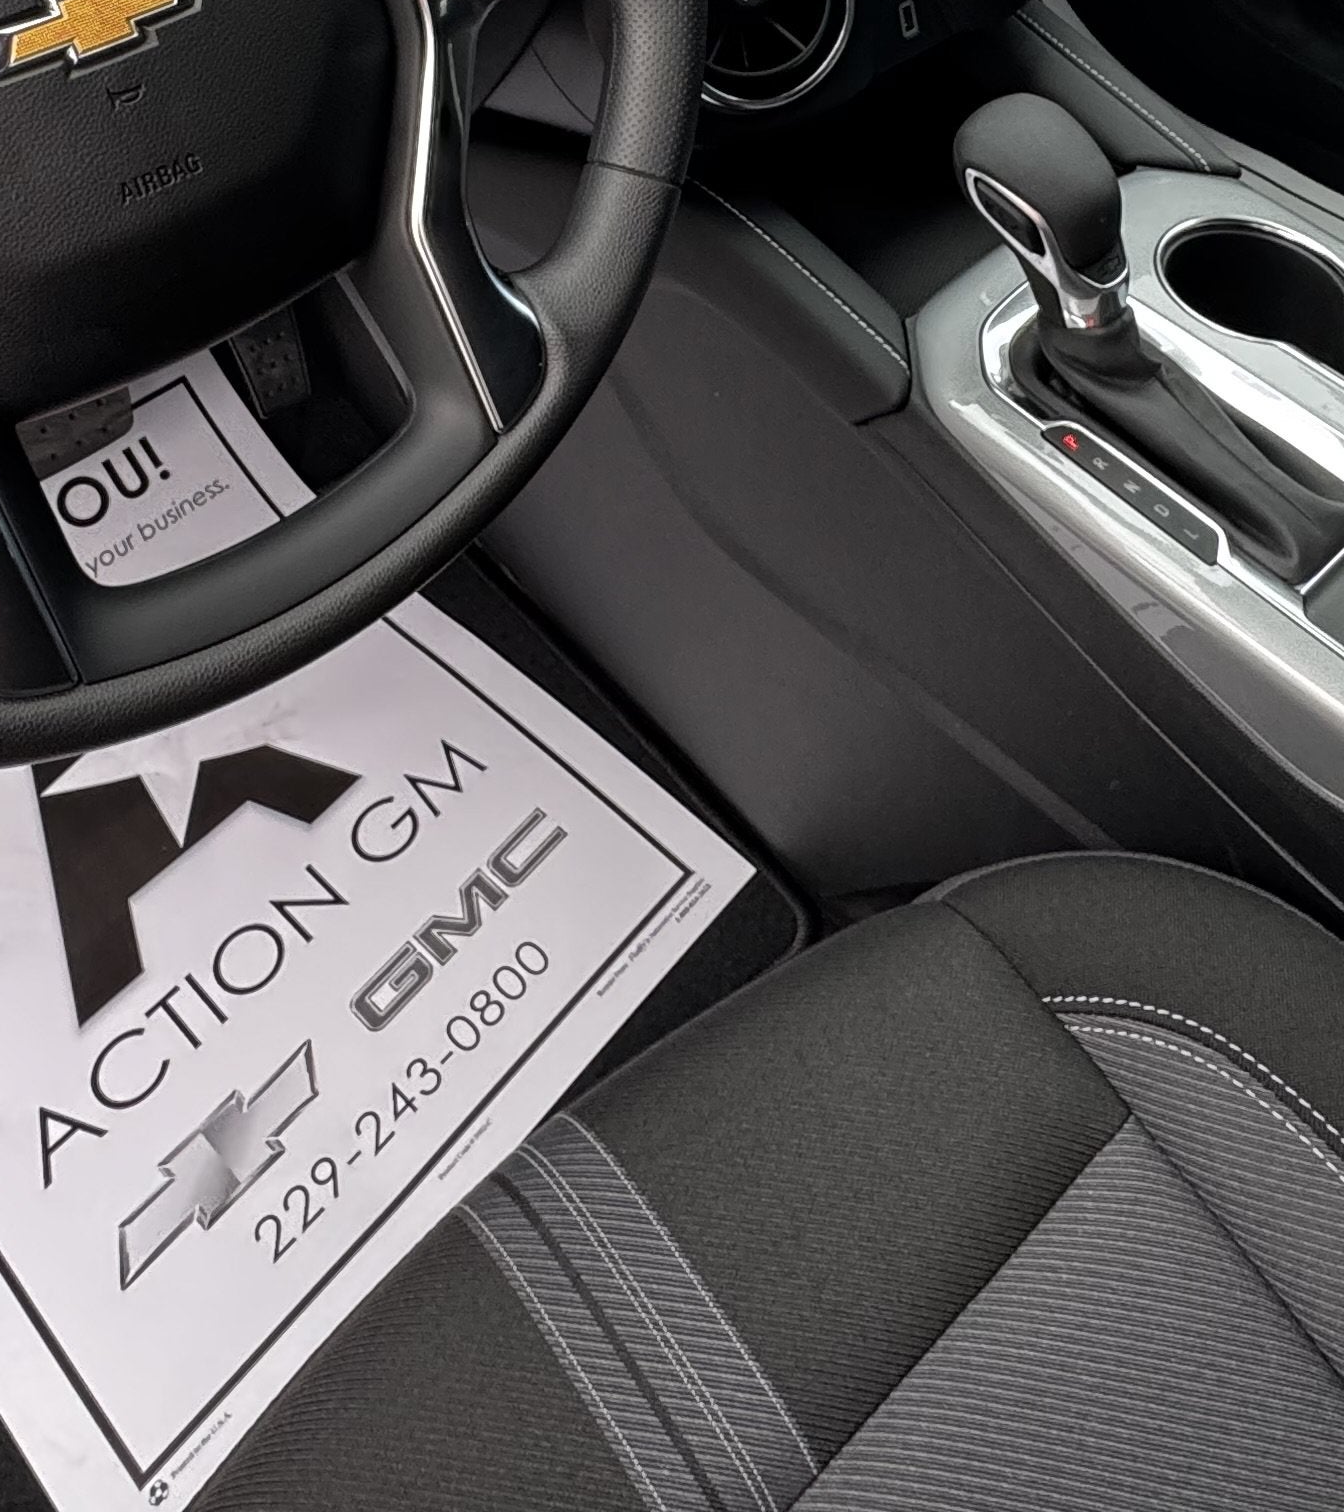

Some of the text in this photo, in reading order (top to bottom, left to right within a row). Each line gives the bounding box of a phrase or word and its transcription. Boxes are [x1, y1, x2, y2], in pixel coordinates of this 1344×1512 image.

[119, 152, 203, 206] AIRBAG
[1062, 434, 1079, 451] P
[1093, 457, 1109, 470] R
[57, 436, 170, 527] OU!
[1123, 479, 1141, 494] N
[86, 478, 230, 578] your business.
[1153, 503, 1170, 517] D
[1183, 529, 1199, 540] L
[349, 806, 569, 1033] GMC
[39, 739, 488, 1190] ACTION GM
[254, 940, 551, 1264] 229-243-0800
